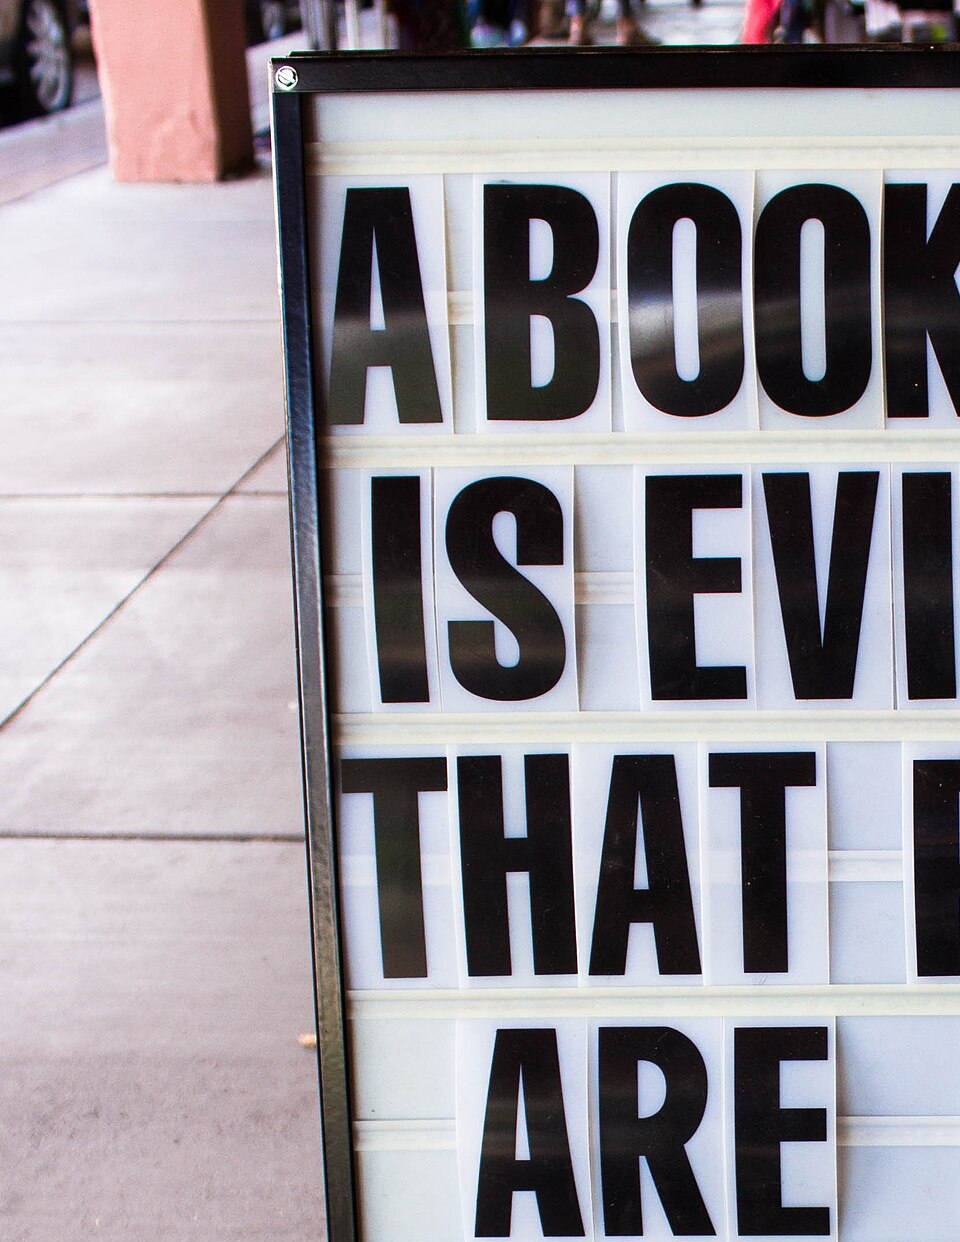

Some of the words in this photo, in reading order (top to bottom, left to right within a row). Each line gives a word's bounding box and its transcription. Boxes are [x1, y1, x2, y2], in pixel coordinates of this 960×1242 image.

[330, 186, 442, 425] A
[371, 475, 567, 704] IS
[341, 752, 817, 978] THAT
[474, 1026, 831, 1239] ARE
